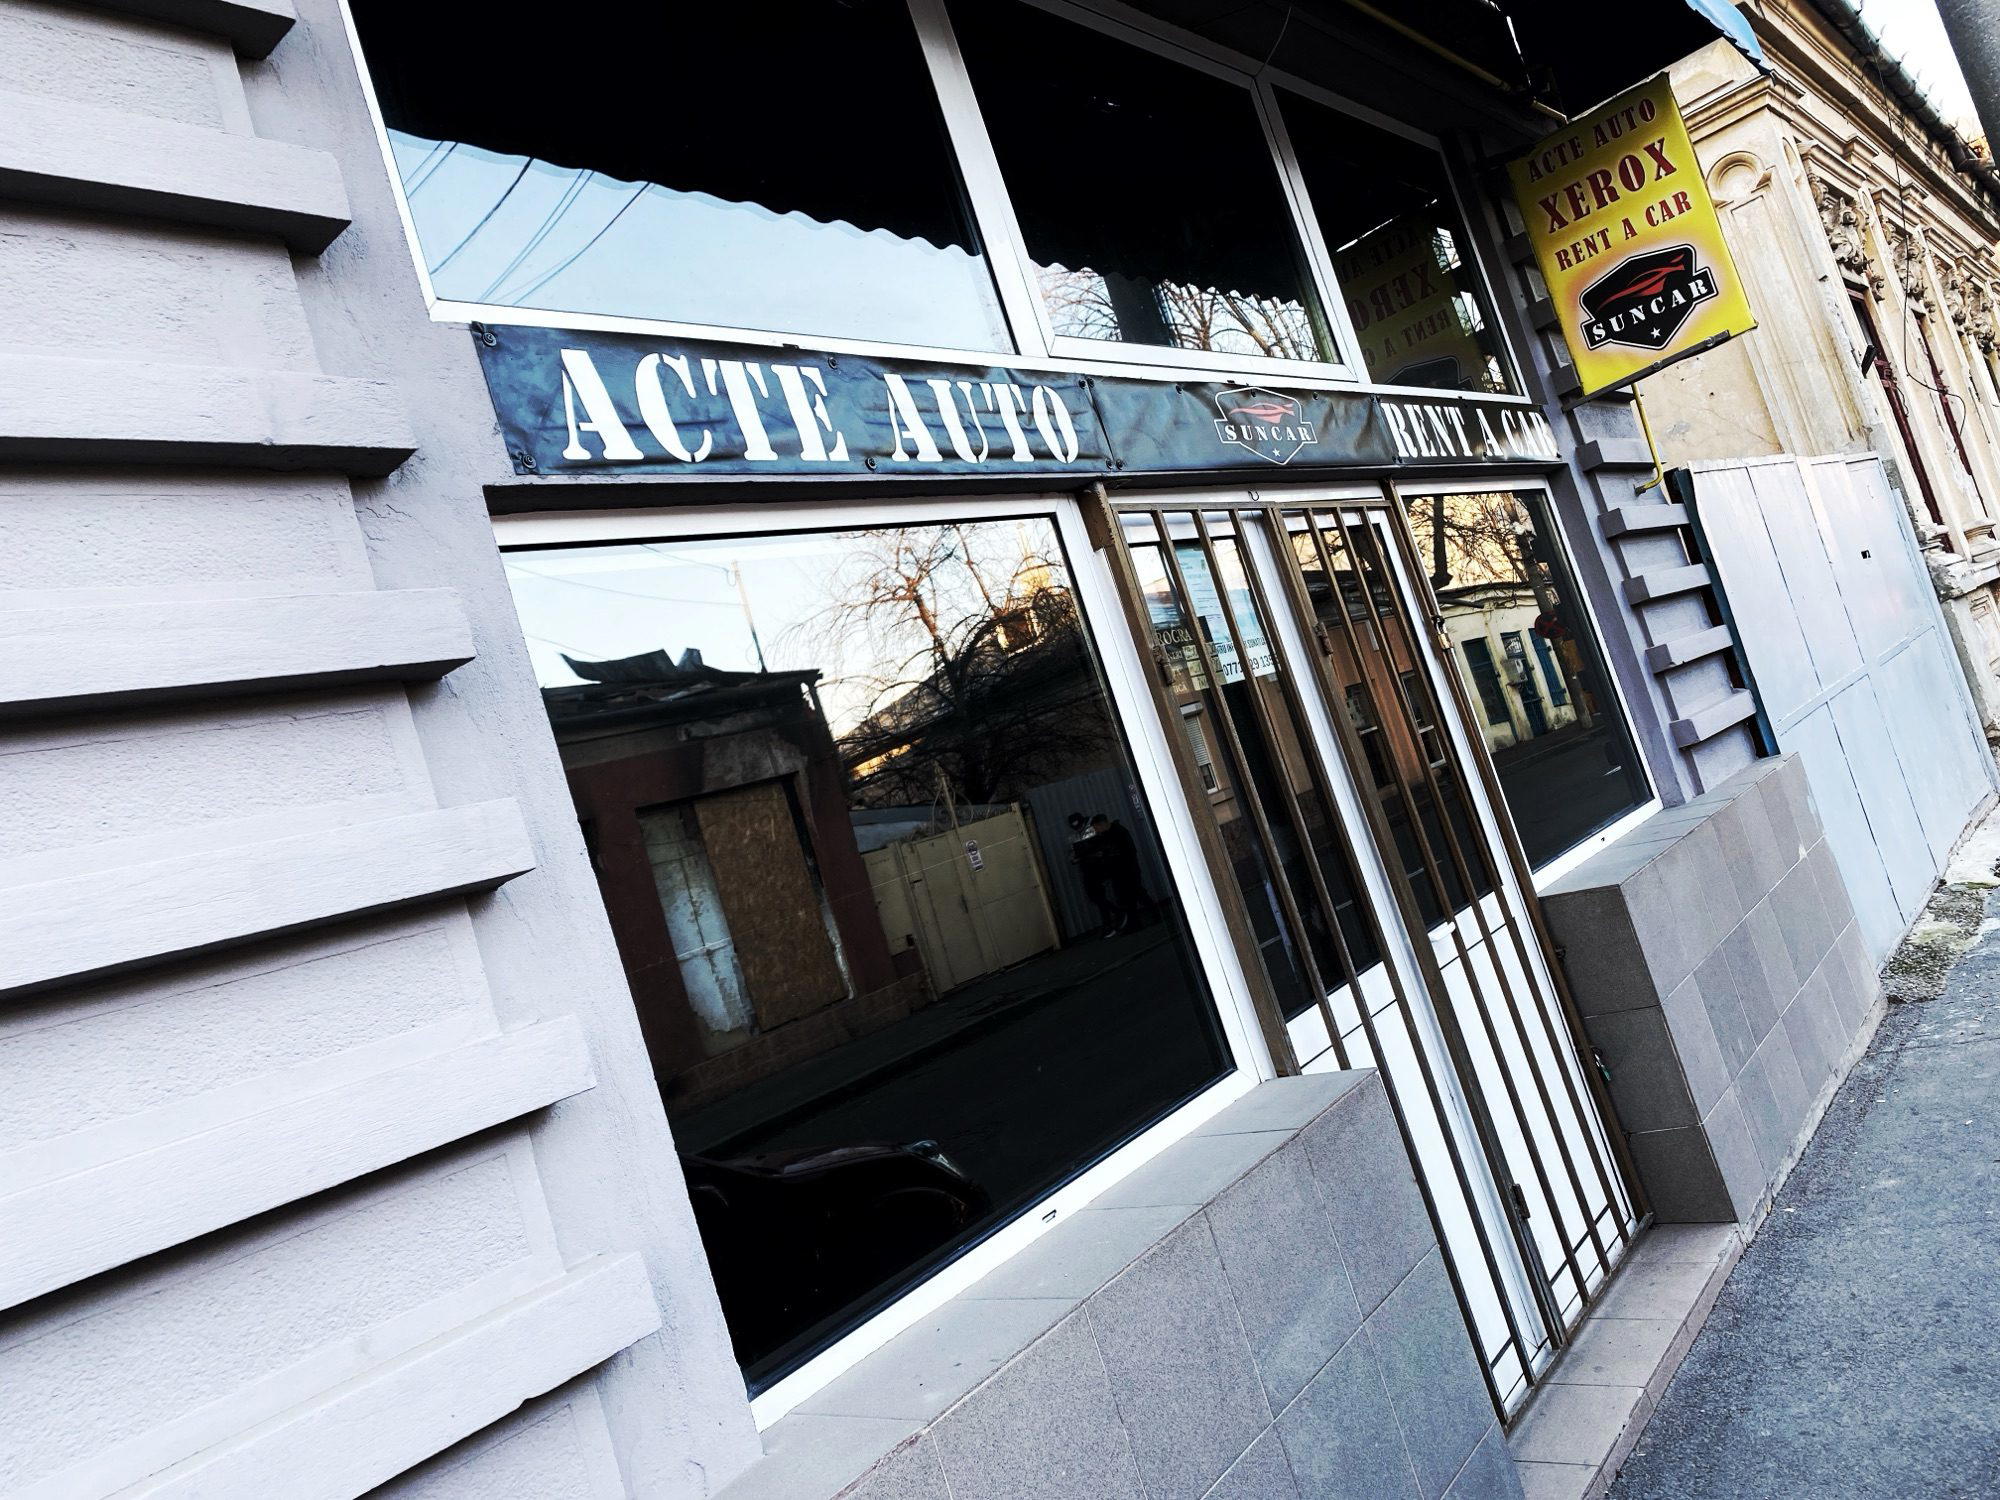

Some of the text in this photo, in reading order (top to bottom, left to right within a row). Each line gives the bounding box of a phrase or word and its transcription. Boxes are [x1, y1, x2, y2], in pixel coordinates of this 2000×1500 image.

[1527, 98, 1656, 183] ACTE AUTO
[1538, 137, 1677, 234] XEROX
[1554, 190, 1692, 272] RENT A CAR
[1591, 278, 1708, 341] SUNCAR
[561, 348, 1080, 464] ACTE AUTO
[1224, 422, 1312, 442] SUNCAR
[1380, 402, 1560, 458] RENT A CAR
